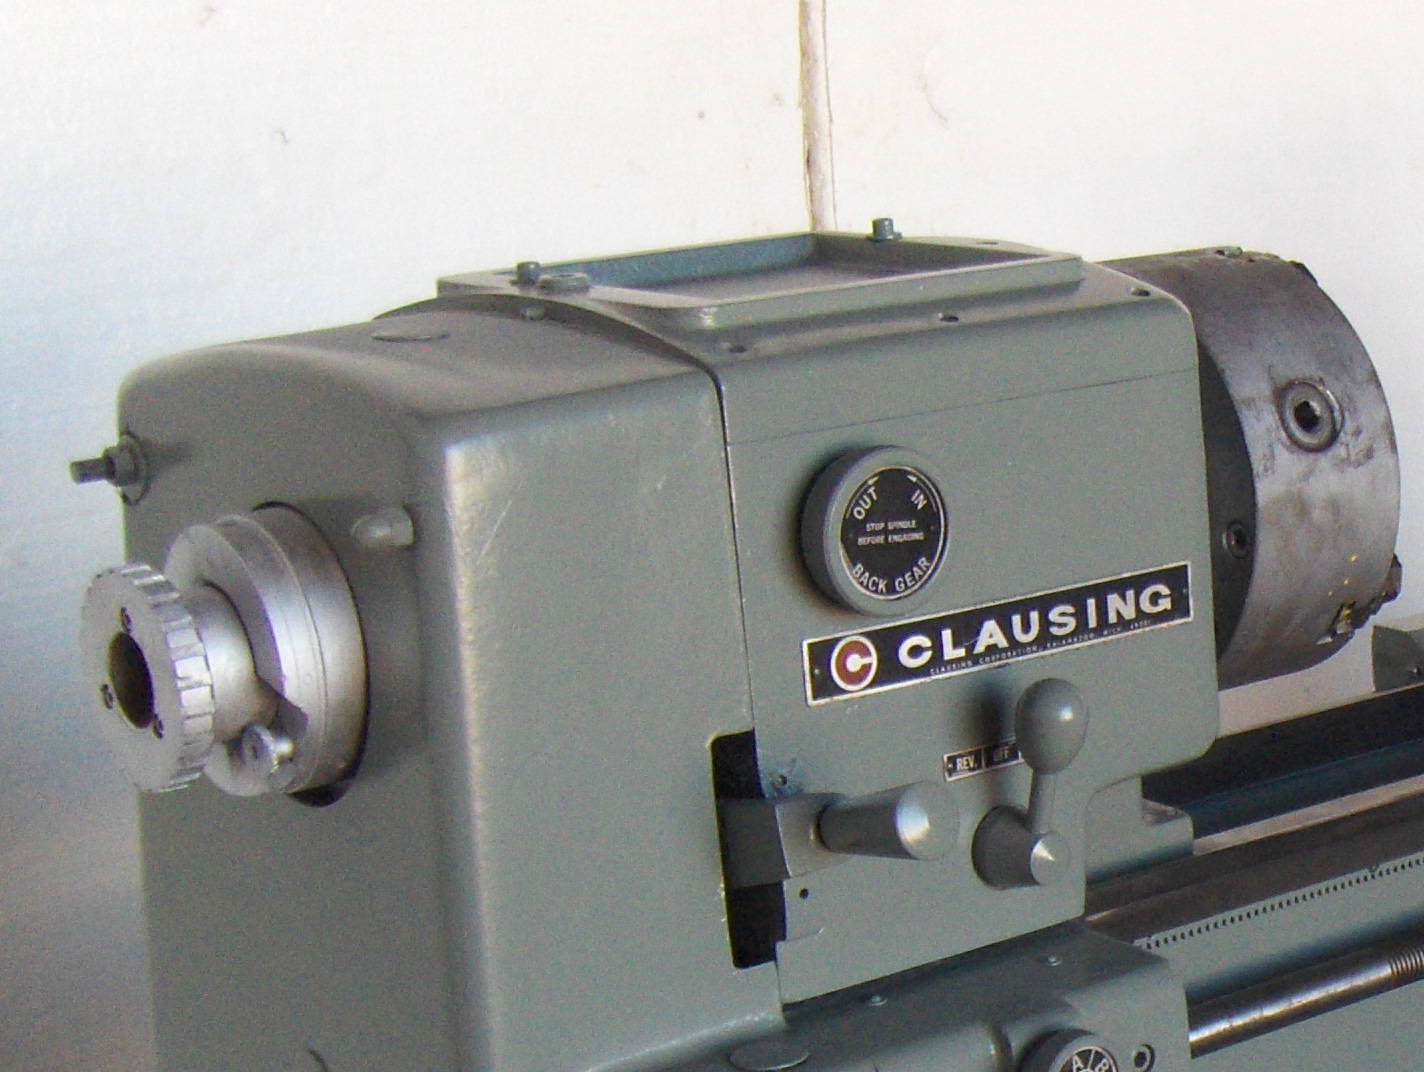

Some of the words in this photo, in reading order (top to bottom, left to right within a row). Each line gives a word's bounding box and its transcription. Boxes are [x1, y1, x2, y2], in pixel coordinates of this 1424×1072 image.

[853, 486, 878, 520] OUT
[911, 488, 928, 510] IN
[857, 534, 886, 546] BEFORE
[866, 522, 886, 532] STOP
[851, 563, 888, 594] BACK
[894, 557, 931, 592] GEAR
[898, 583, 1172, 668] CLAUSING
[955, 754, 978, 773] REV.
